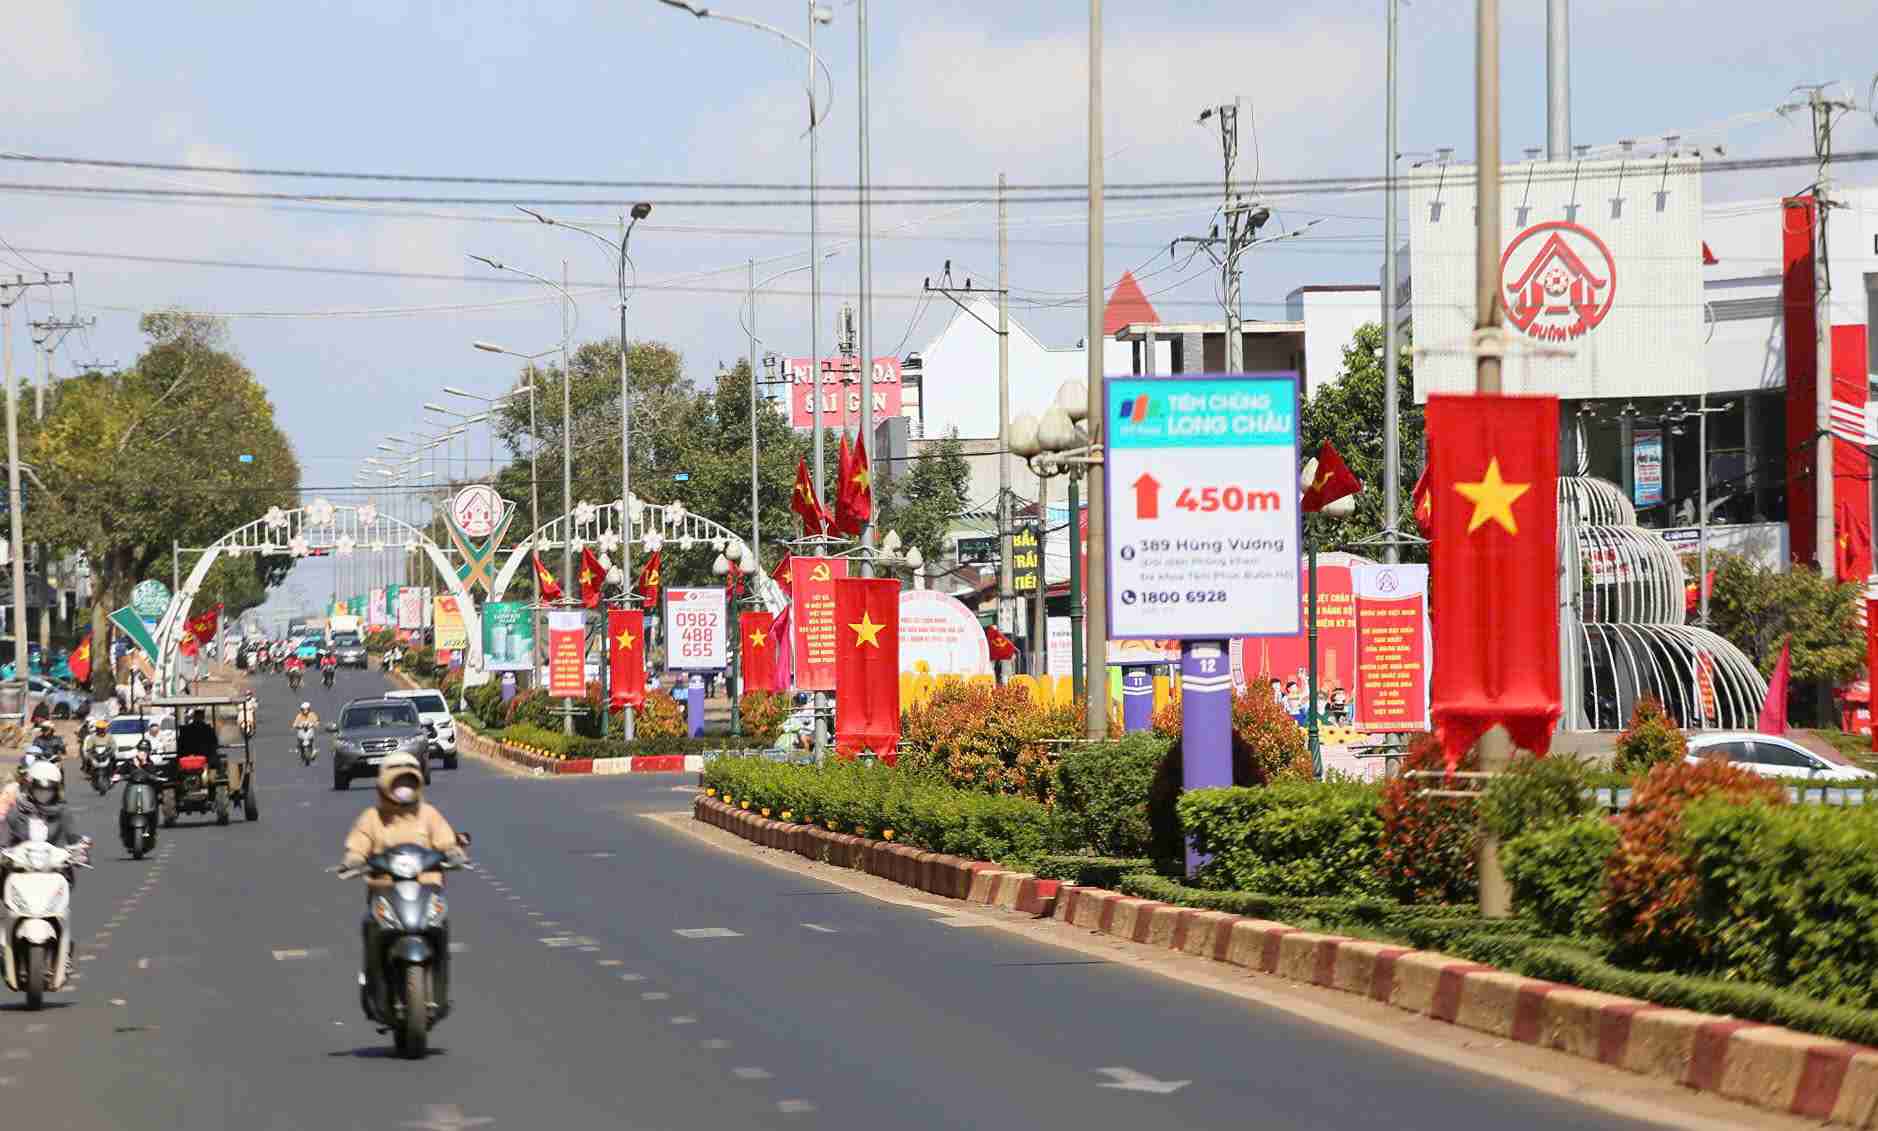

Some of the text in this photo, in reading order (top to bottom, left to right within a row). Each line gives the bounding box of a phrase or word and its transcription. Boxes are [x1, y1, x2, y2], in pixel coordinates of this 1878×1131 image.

[1168, 414, 1227, 435] LONG
[1232, 409, 1291, 434] CHÂU
[1175, 486, 1281, 512] 450m
[1140, 538, 1170, 552] 389
[1176, 538, 1223, 554] Hùng
[1141, 590, 1228, 604] 1800 6928
[676, 613, 719, 627] 0982
[682, 628, 713, 642] 488
[682, 643, 713, 657] 655
[1200, 659, 1216, 673] 12
